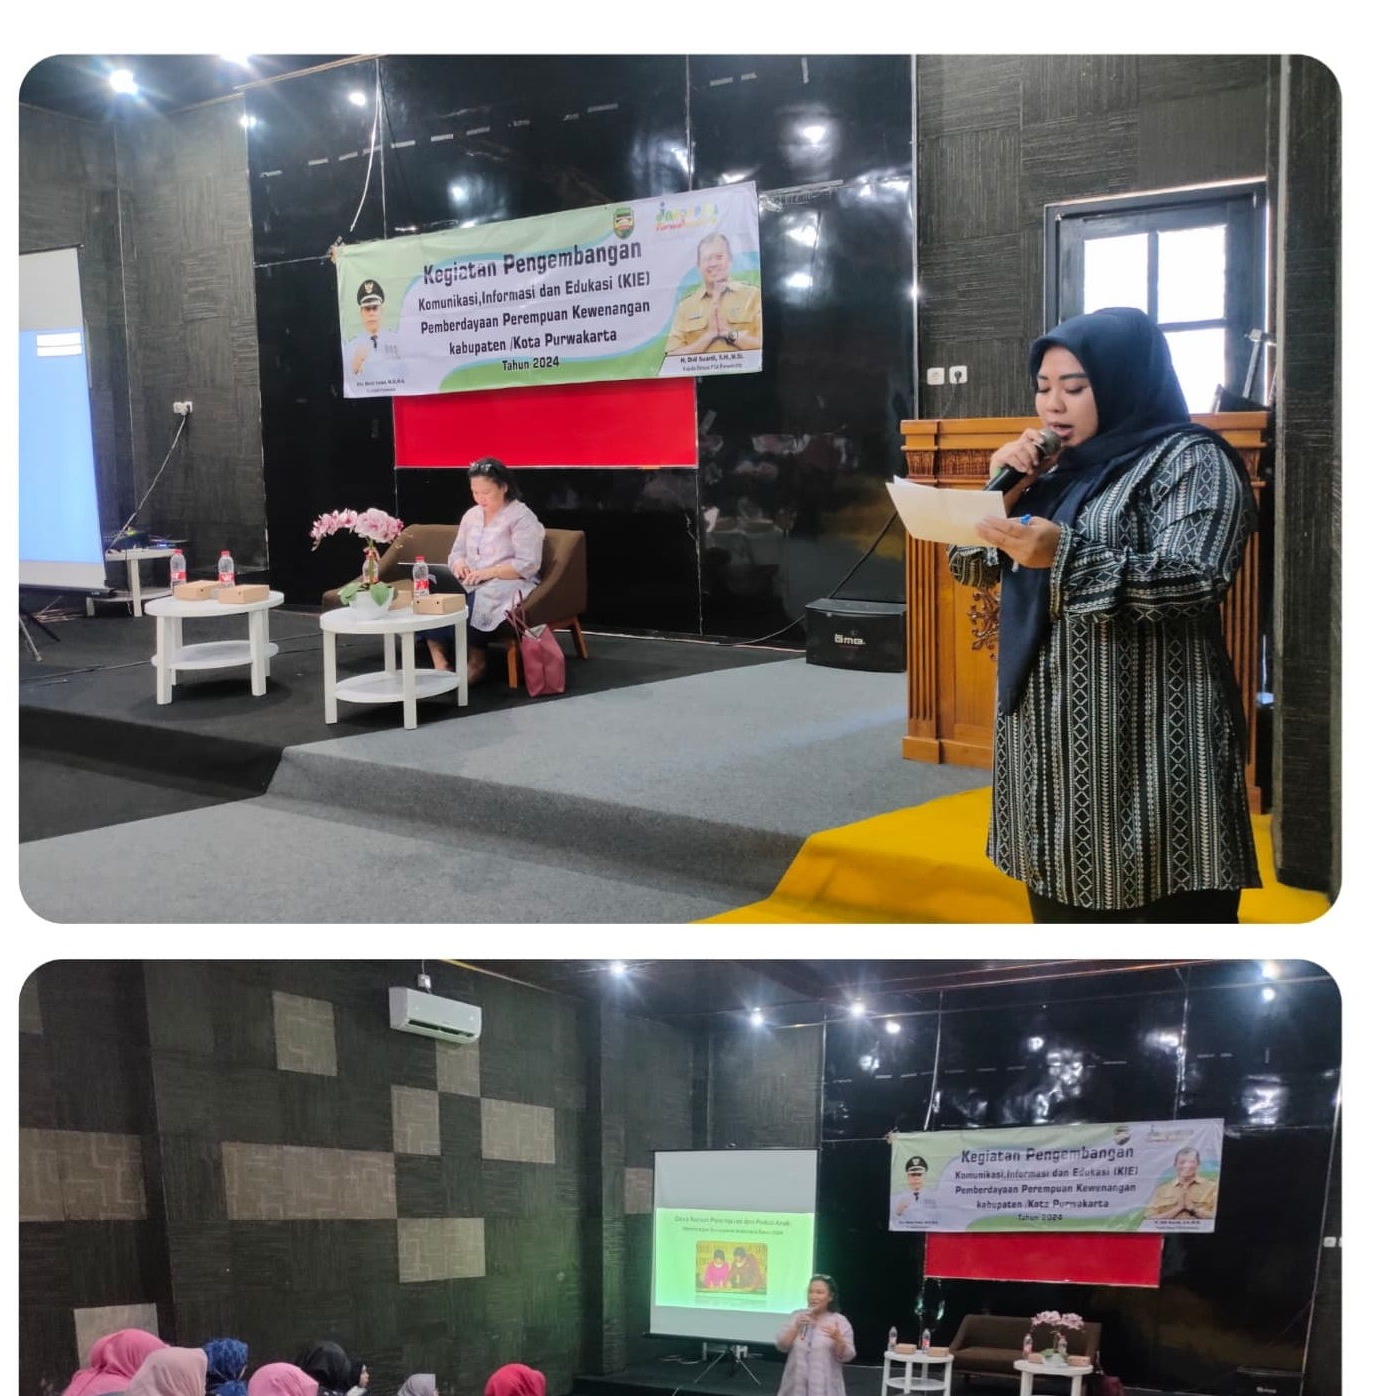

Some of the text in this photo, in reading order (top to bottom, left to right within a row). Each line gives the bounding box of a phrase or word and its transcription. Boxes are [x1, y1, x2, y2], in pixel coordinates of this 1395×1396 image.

[423, 239, 642, 286] Kegiatan Pengembangan
[418, 271, 651, 312] Komunikasi,Informasi dan Edukasi (KIE)
[421, 300, 651, 335] Pemberdayaan Perempuan Kewenangan
[449, 329, 617, 357] kabupaten /Kota Purwakarta
[502, 357, 560, 371] Tahun 2024
